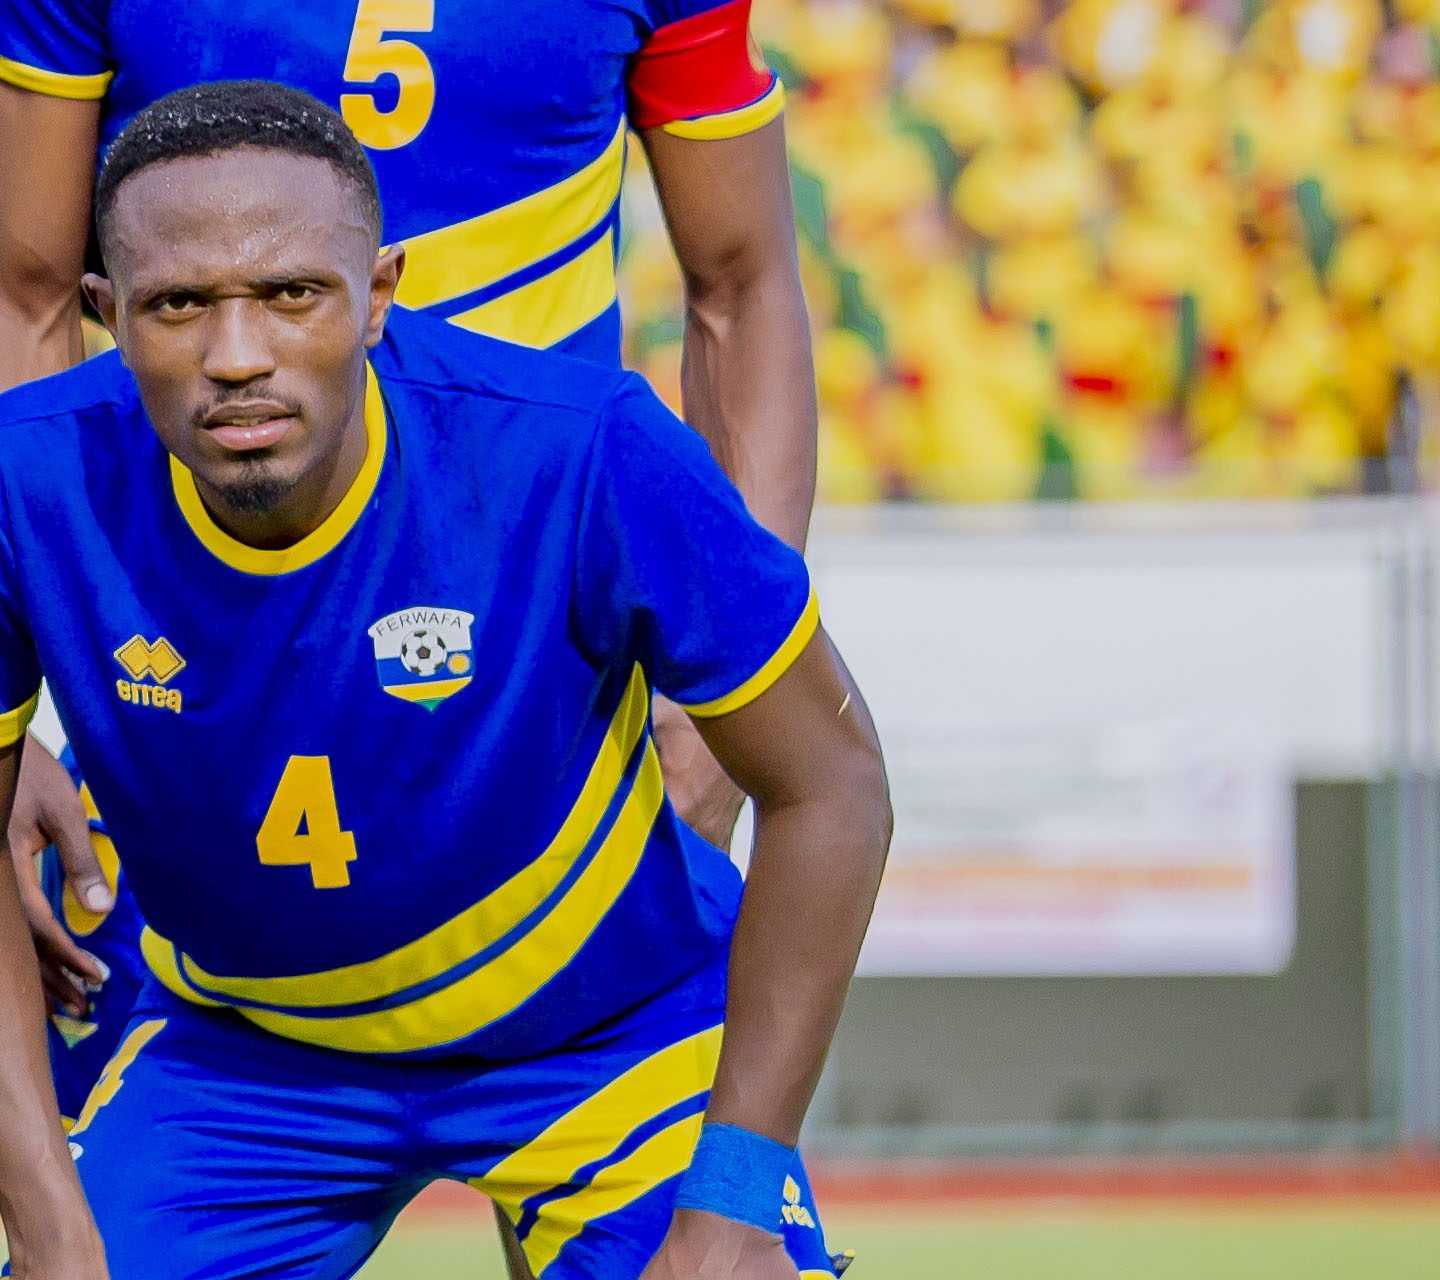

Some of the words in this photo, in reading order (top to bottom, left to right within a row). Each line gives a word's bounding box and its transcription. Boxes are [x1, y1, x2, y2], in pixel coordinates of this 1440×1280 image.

[375, 611, 461, 637] FERWAFA
[116, 678, 182, 714] errea
[256, 754, 358, 889] 4
